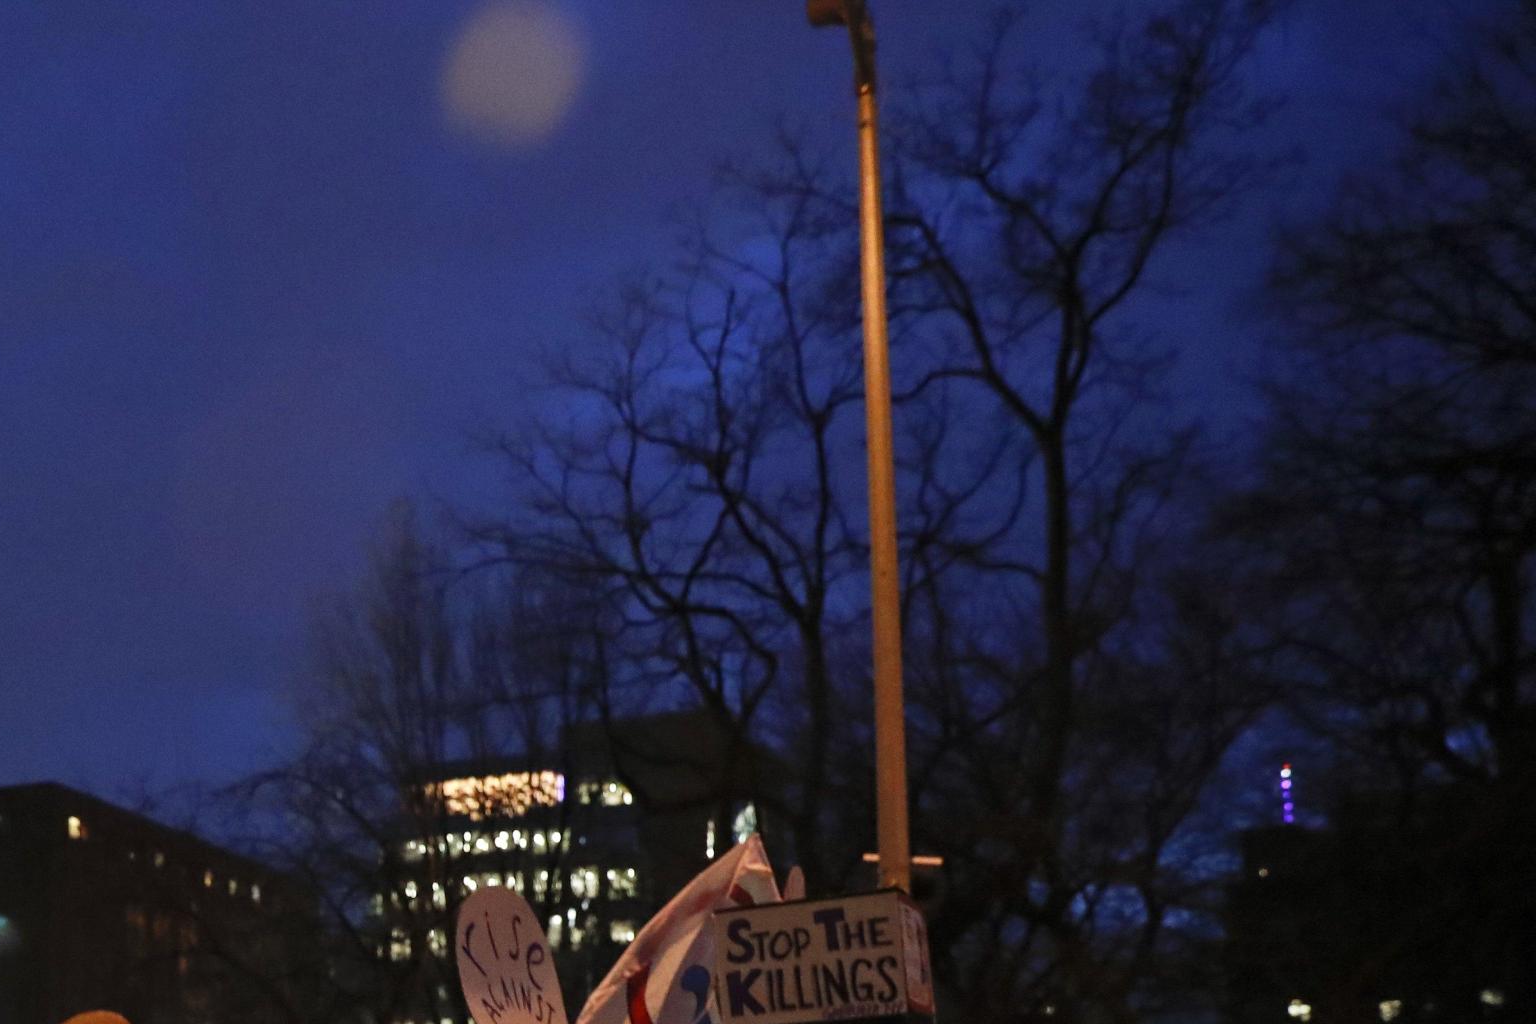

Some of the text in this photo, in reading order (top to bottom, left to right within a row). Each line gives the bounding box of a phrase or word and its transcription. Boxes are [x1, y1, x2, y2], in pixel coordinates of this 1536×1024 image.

[727, 918, 811, 963] STOP
[813, 908, 893, 951] THE
[726, 956, 898, 1017] KILLINGS
